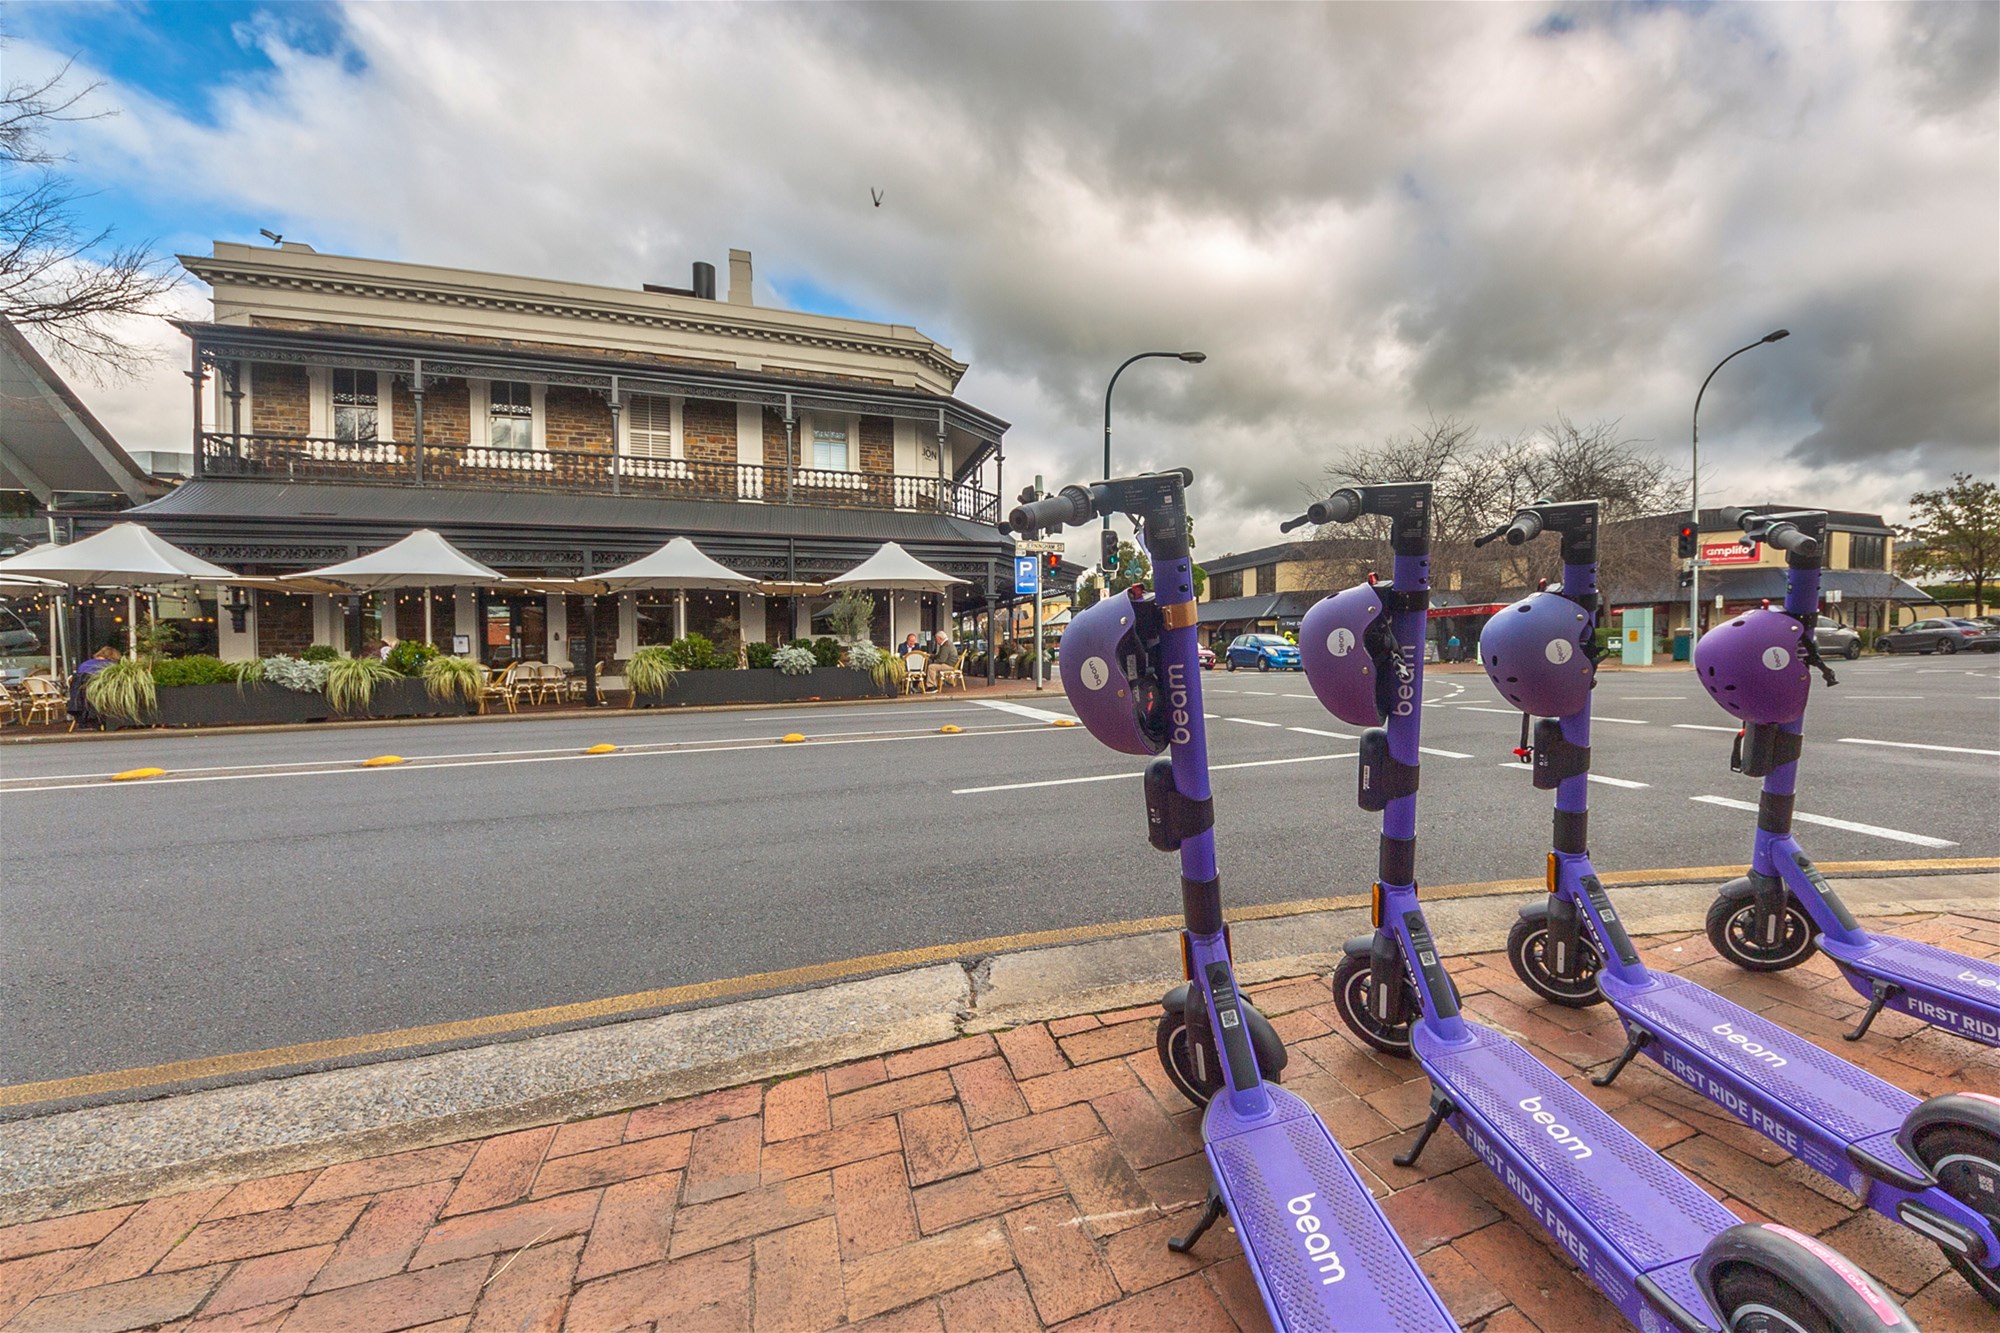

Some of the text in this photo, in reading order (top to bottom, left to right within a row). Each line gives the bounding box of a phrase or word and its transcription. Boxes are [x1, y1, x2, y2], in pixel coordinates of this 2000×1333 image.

[1020, 562, 1033, 576] P
[1706, 545, 1750, 557] amplifo
[1088, 661, 1102, 686] beam
[1392, 645, 1416, 716] beam
[1168, 664, 1191, 744] beam
[1957, 971, 2000, 992] be
[1908, 997, 1958, 1025] FIRST
[1712, 1023, 1787, 1068] beam
[1663, 1050, 1798, 1151] FIRST RIDE FREE
[1519, 1096, 1593, 1160] beam
[1465, 1123, 1590, 1269] FIRST RIDE FREE
[1287, 1192, 1346, 1286] beam
[1847, 1273, 1861, 1287] ON
[1861, 1282, 1880, 1304] THIS
